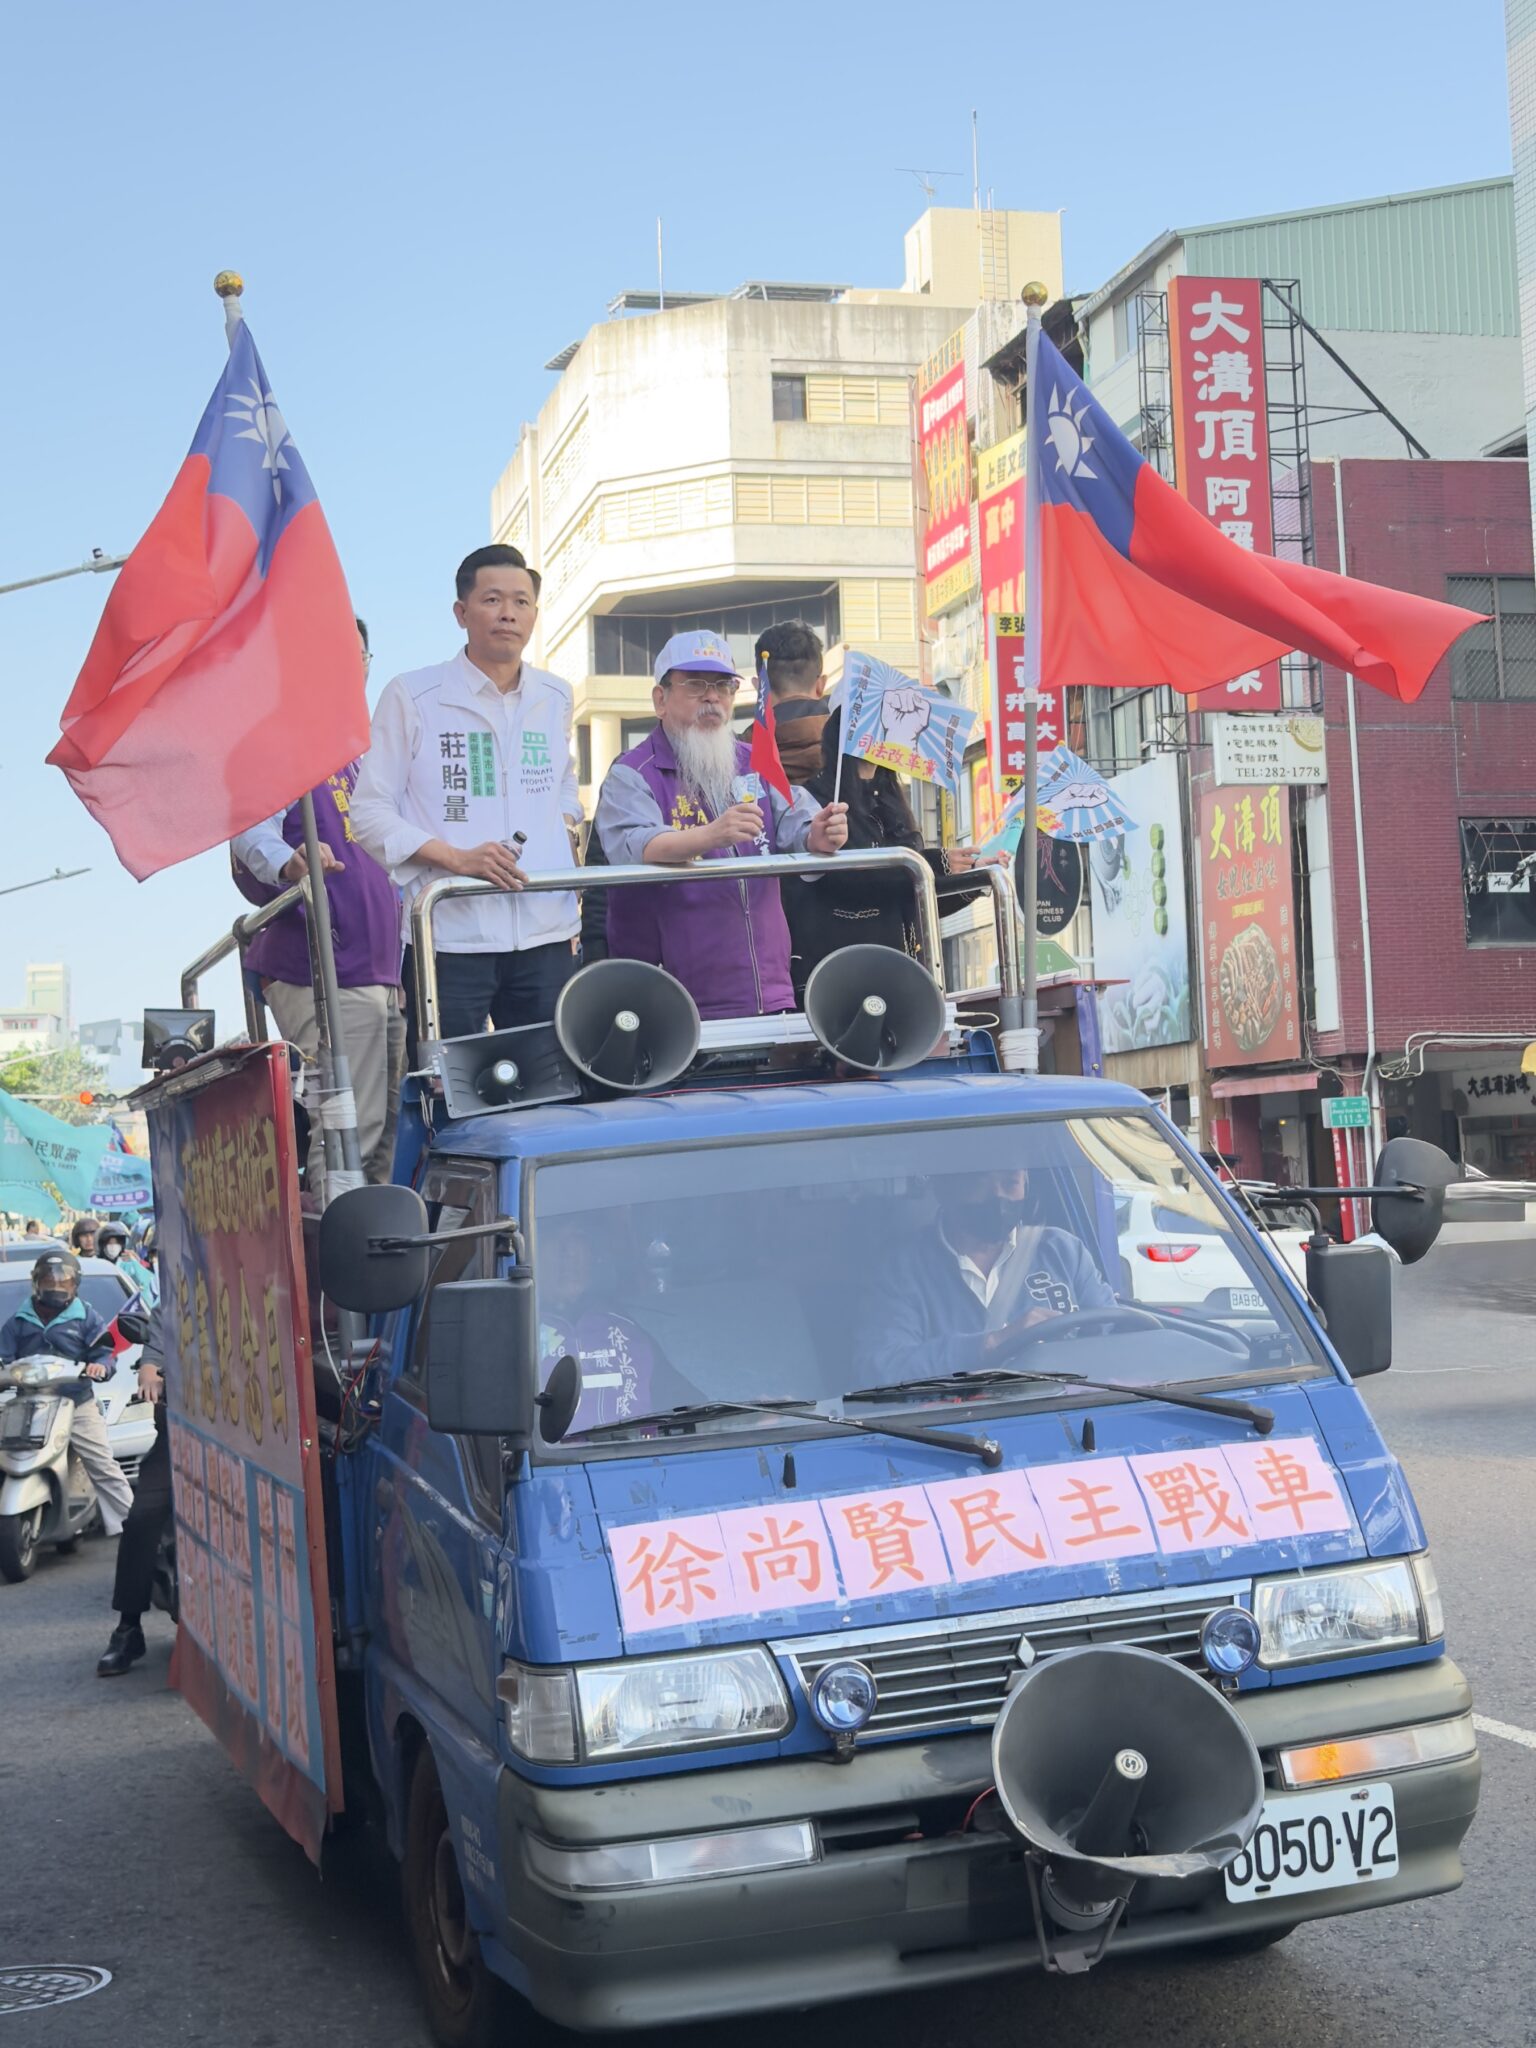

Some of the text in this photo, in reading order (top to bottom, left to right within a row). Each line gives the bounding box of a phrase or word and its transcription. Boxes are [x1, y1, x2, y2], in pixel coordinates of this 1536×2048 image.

[1190, 291, 1257, 461] 大溝頂
[522, 767, 553, 776] TAIWAN
[439, 731, 469, 822] 莊貽量
[526, 786, 551, 794] PARTY
[1037, 907, 1064, 915] SINESS
[1043, 915, 1062, 923] CLUB
[624, 1446, 1335, 1616] 徐尚賢民主戰車
